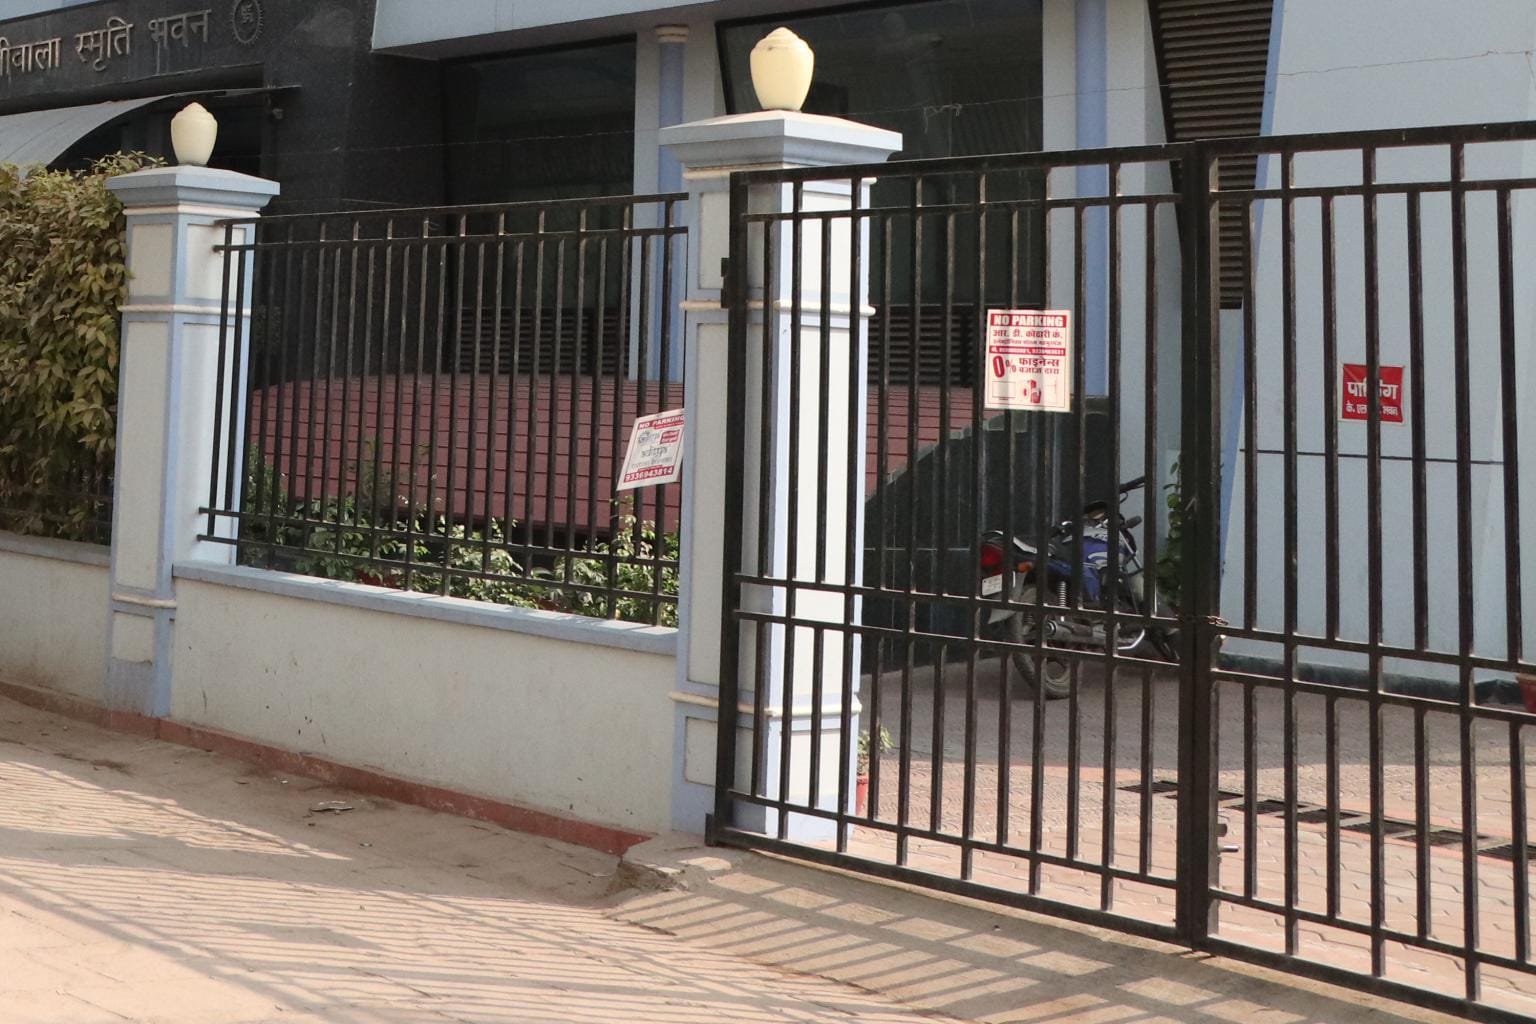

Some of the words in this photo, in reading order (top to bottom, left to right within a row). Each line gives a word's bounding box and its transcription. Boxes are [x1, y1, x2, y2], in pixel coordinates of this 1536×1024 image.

[74, 16, 134, 72] स्मृति
[148, 9, 212, 49] भवन
[994, 315, 1009, 326] NO
[1012, 315, 1063, 327] PARKING
